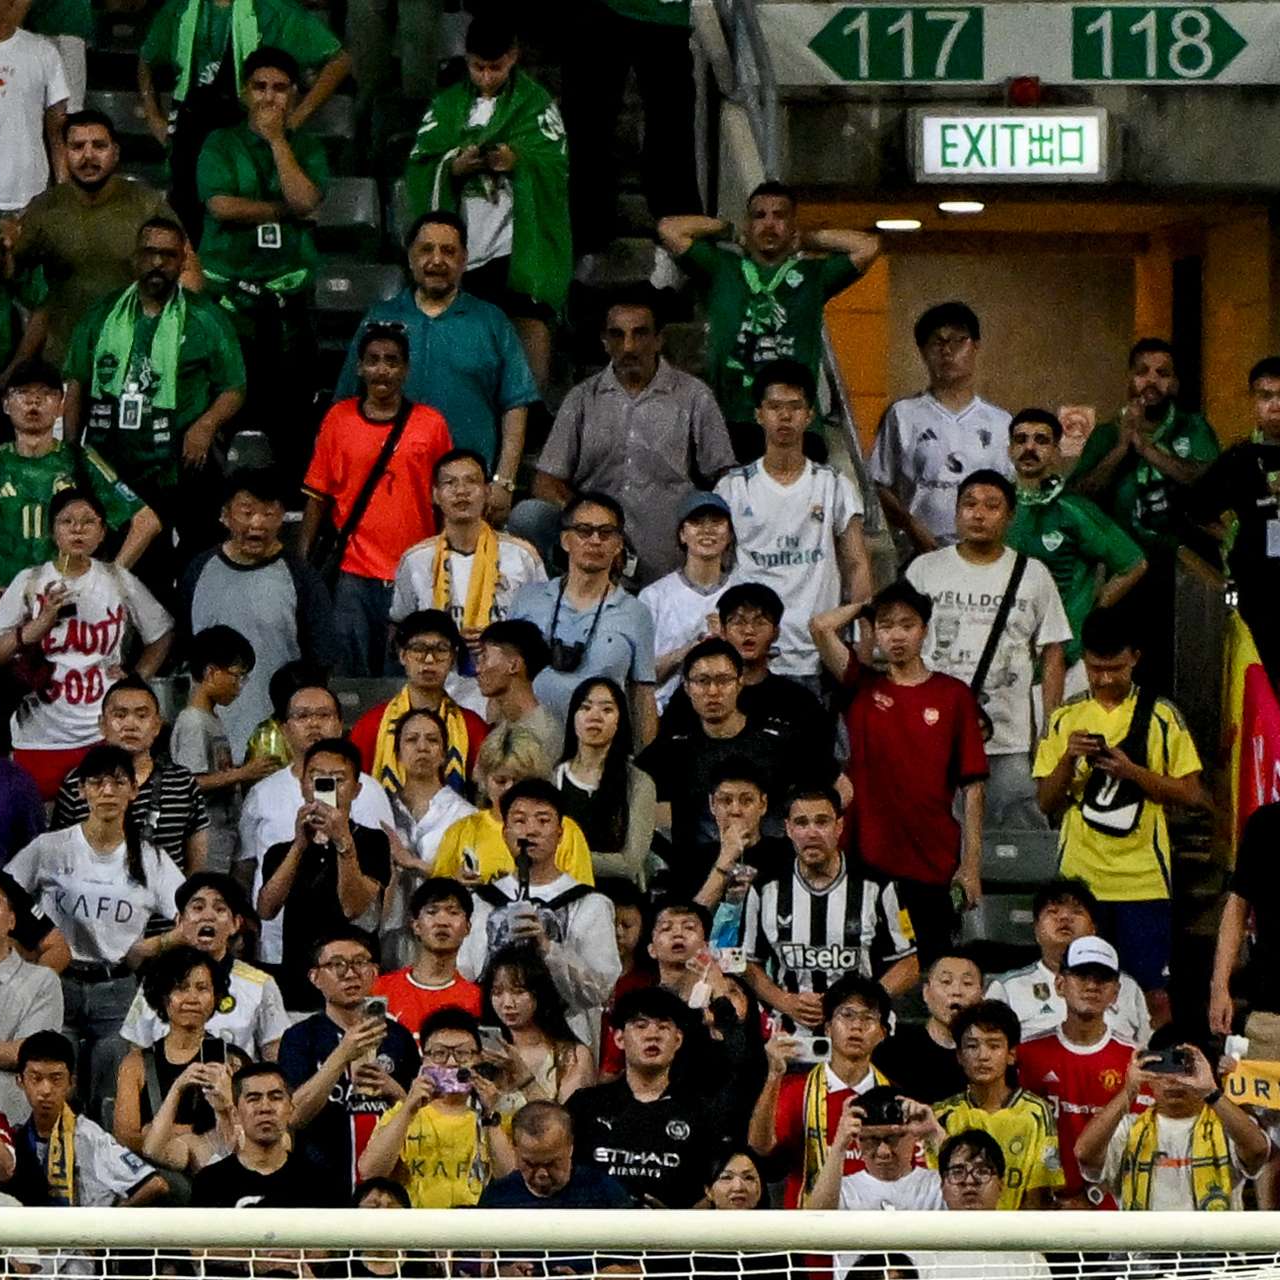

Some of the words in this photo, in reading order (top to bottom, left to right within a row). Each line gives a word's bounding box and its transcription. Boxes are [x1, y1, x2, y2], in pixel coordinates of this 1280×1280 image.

[842, 10, 970, 79] 117
[1085, 9, 1213, 79] 118
[940, 124, 1023, 168] EXIT
[1028, 125, 1084, 167] 出口
[22, 504, 42, 540] 11
[931, 591, 1029, 612] WELLDOE
[55, 892, 134, 924] KAFD
[805, 946, 858, 970] sela
[593, 1146, 680, 1167] ETIHAD
[608, 1167, 661, 1179] AIRWAYS
